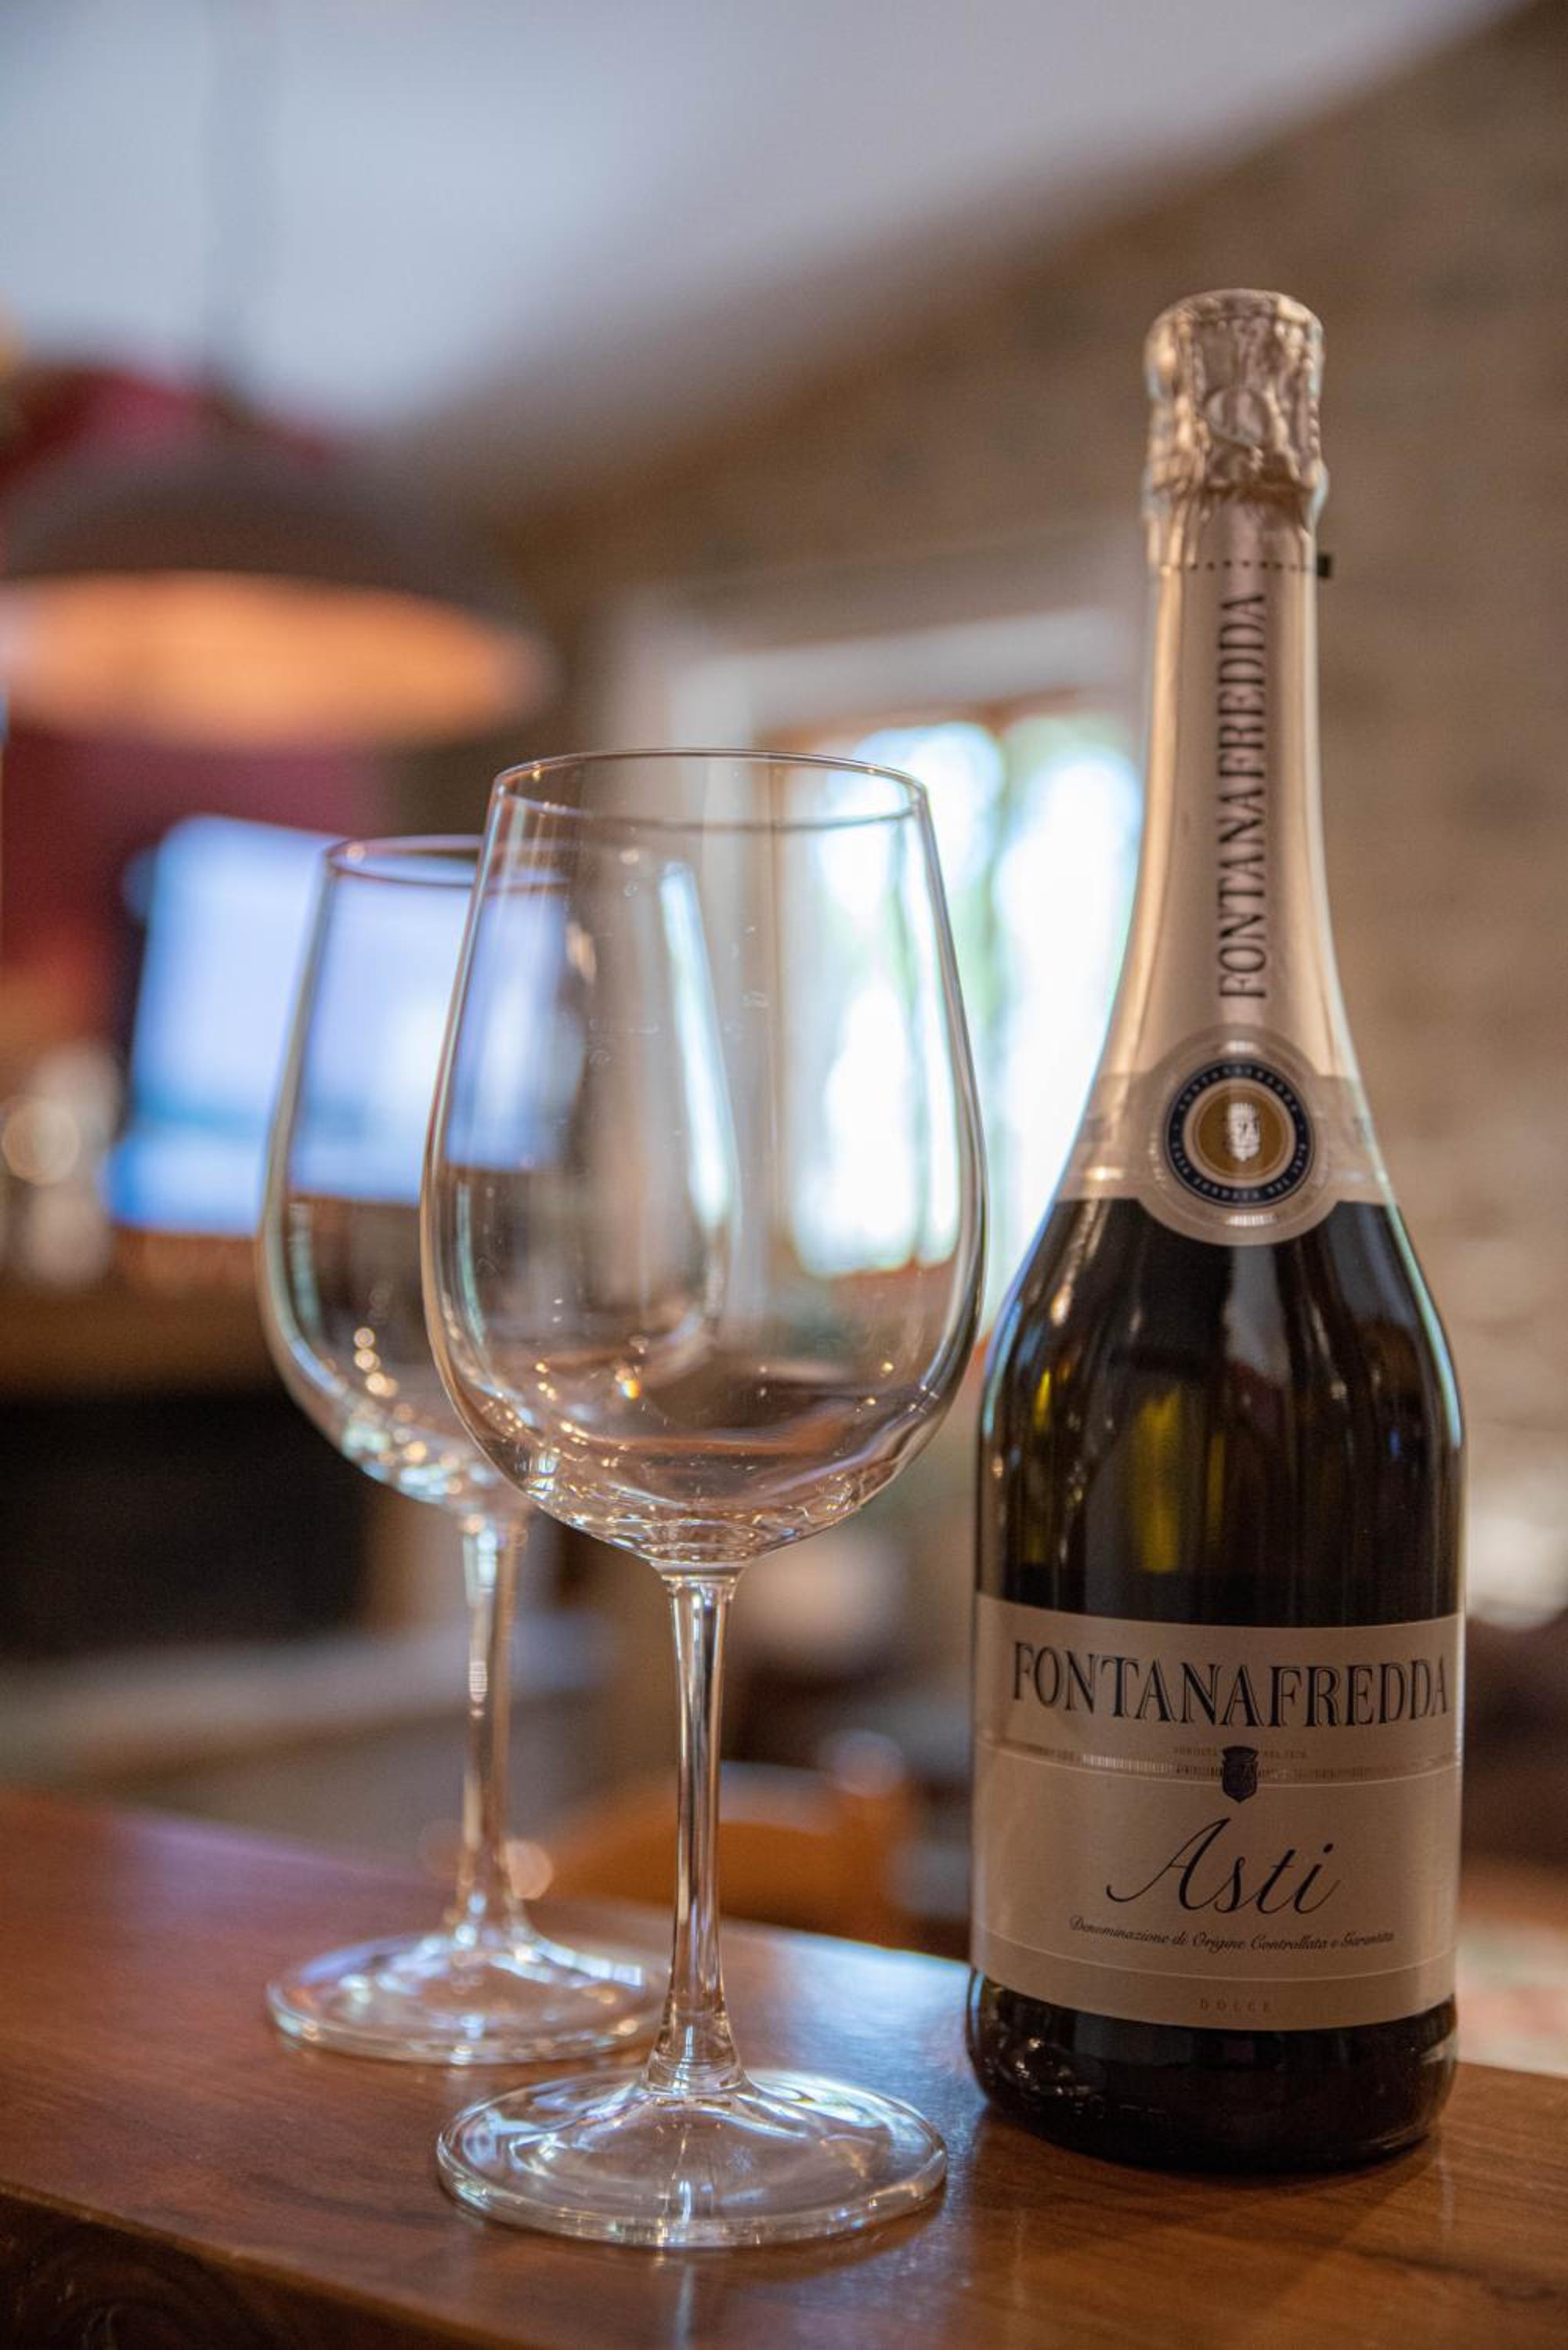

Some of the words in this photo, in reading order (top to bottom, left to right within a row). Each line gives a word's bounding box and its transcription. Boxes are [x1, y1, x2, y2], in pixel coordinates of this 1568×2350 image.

[1218, 594, 1267, 1000] FONTANAFREDDA
[1013, 1640, 1451, 1728] FONTANAFREDDA
[1106, 1817, 1342, 1914] Asti
[1071, 1916, 1169, 1944] Denominazione
[1171, 1930, 1188, 1946] di
[1192, 1931, 1245, 1954] Origine
